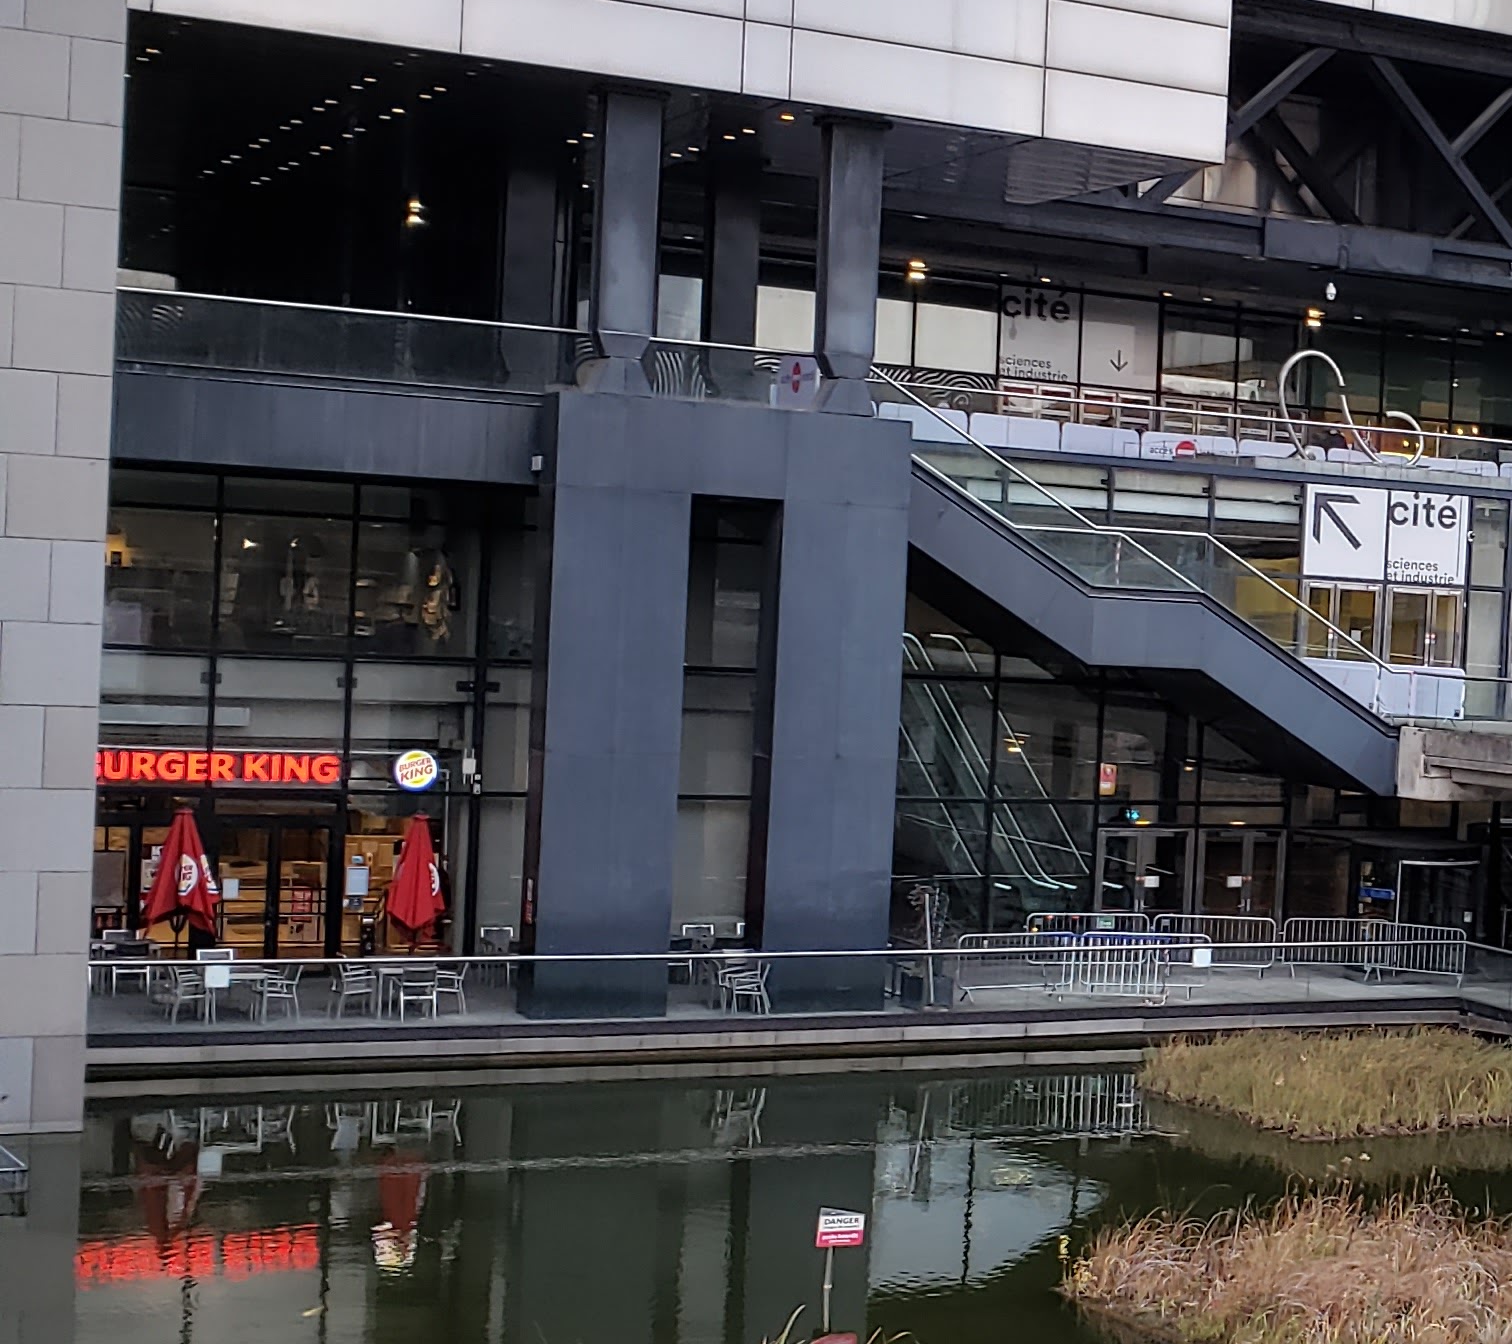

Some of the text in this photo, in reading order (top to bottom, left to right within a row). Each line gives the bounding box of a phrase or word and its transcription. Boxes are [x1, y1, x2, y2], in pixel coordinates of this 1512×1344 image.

[1002, 287, 1071, 323] cité
[999, 355, 1052, 369] sciences
[1014, 367, 1068, 382] industrie
[1389, 492, 1457, 529] cité
[1387, 557, 1438, 571] sciences
[1386, 570, 1455, 585] et industrie
[96, 751, 341, 784] URGER KING
[399, 757, 432, 772] BURGER
[401, 764, 433, 782] KING
[824, 1217, 860, 1225] DANGER
